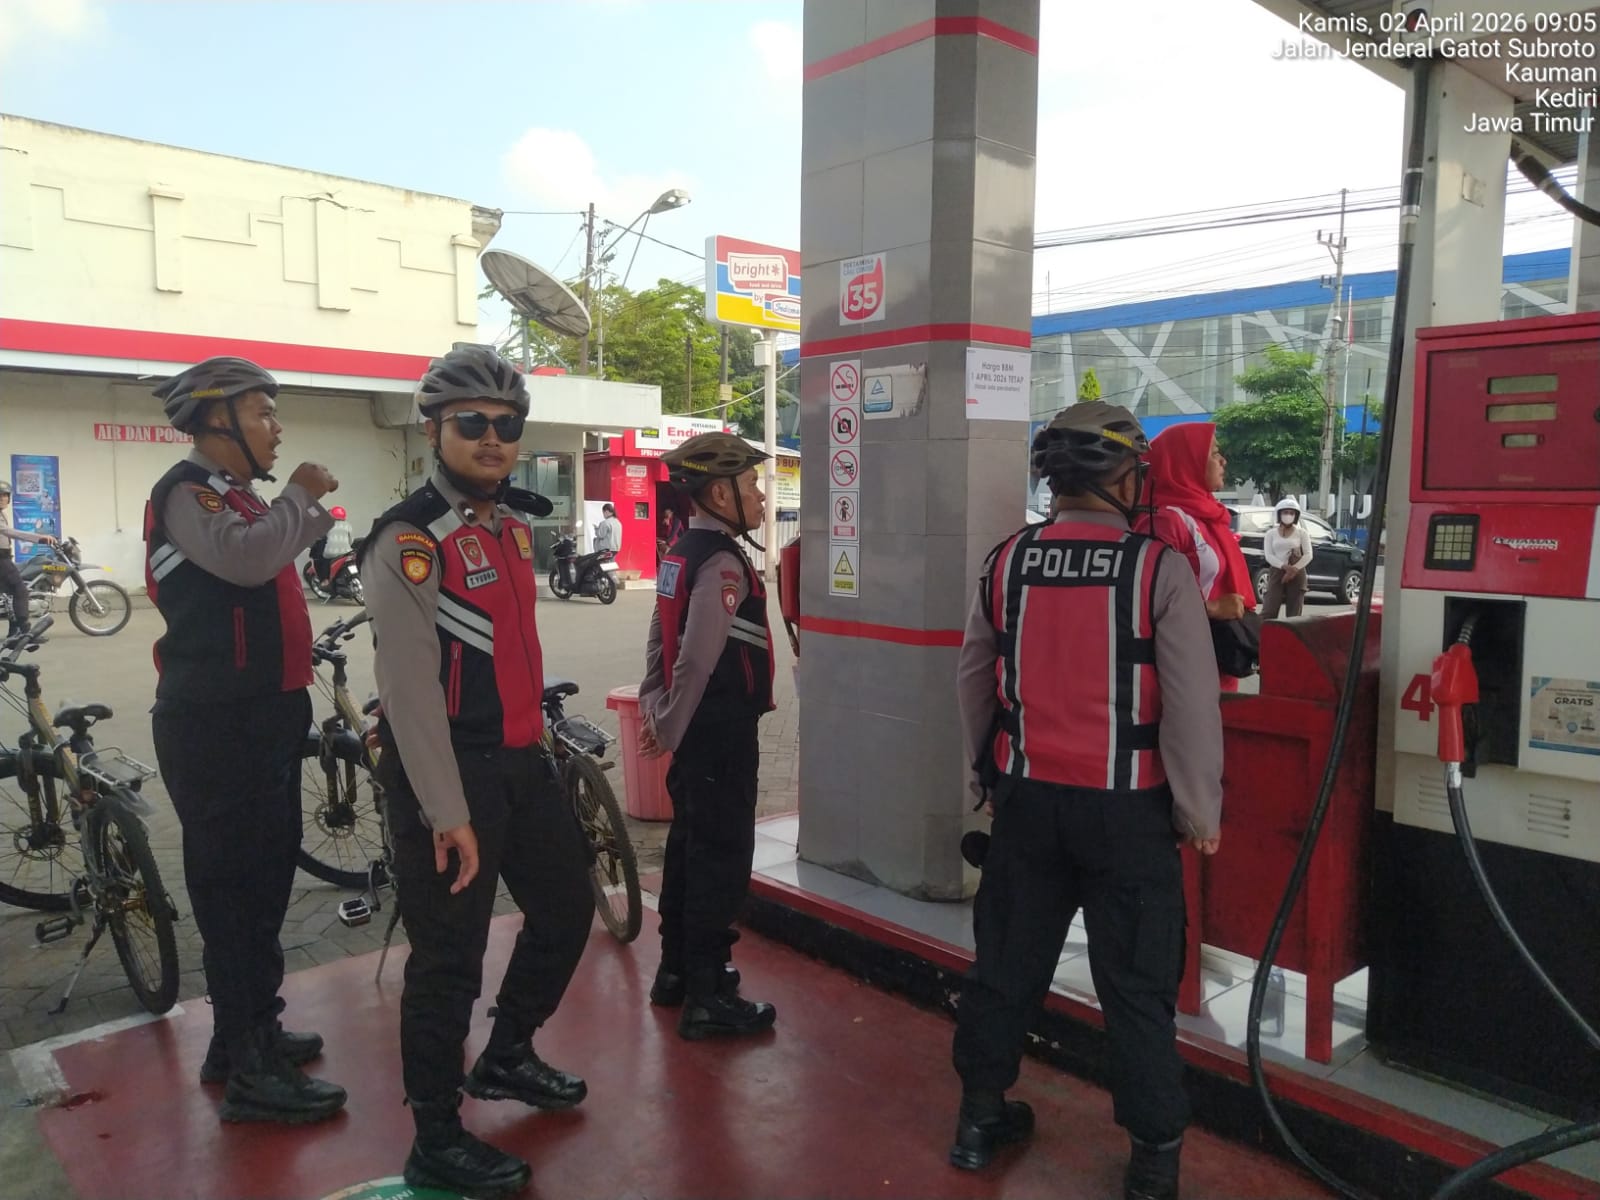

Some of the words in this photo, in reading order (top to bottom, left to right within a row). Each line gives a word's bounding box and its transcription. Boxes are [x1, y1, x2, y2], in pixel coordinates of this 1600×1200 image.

[734, 262, 770, 278] bright
[843, 282, 877, 313] 135
[98, 425, 122, 441] AIR
[126, 426, 151, 441] DAN
[1021, 547, 1124, 578] POLISI
[1400, 673, 1435, 721] 4
[1554, 697, 1593, 706] GRATIS
